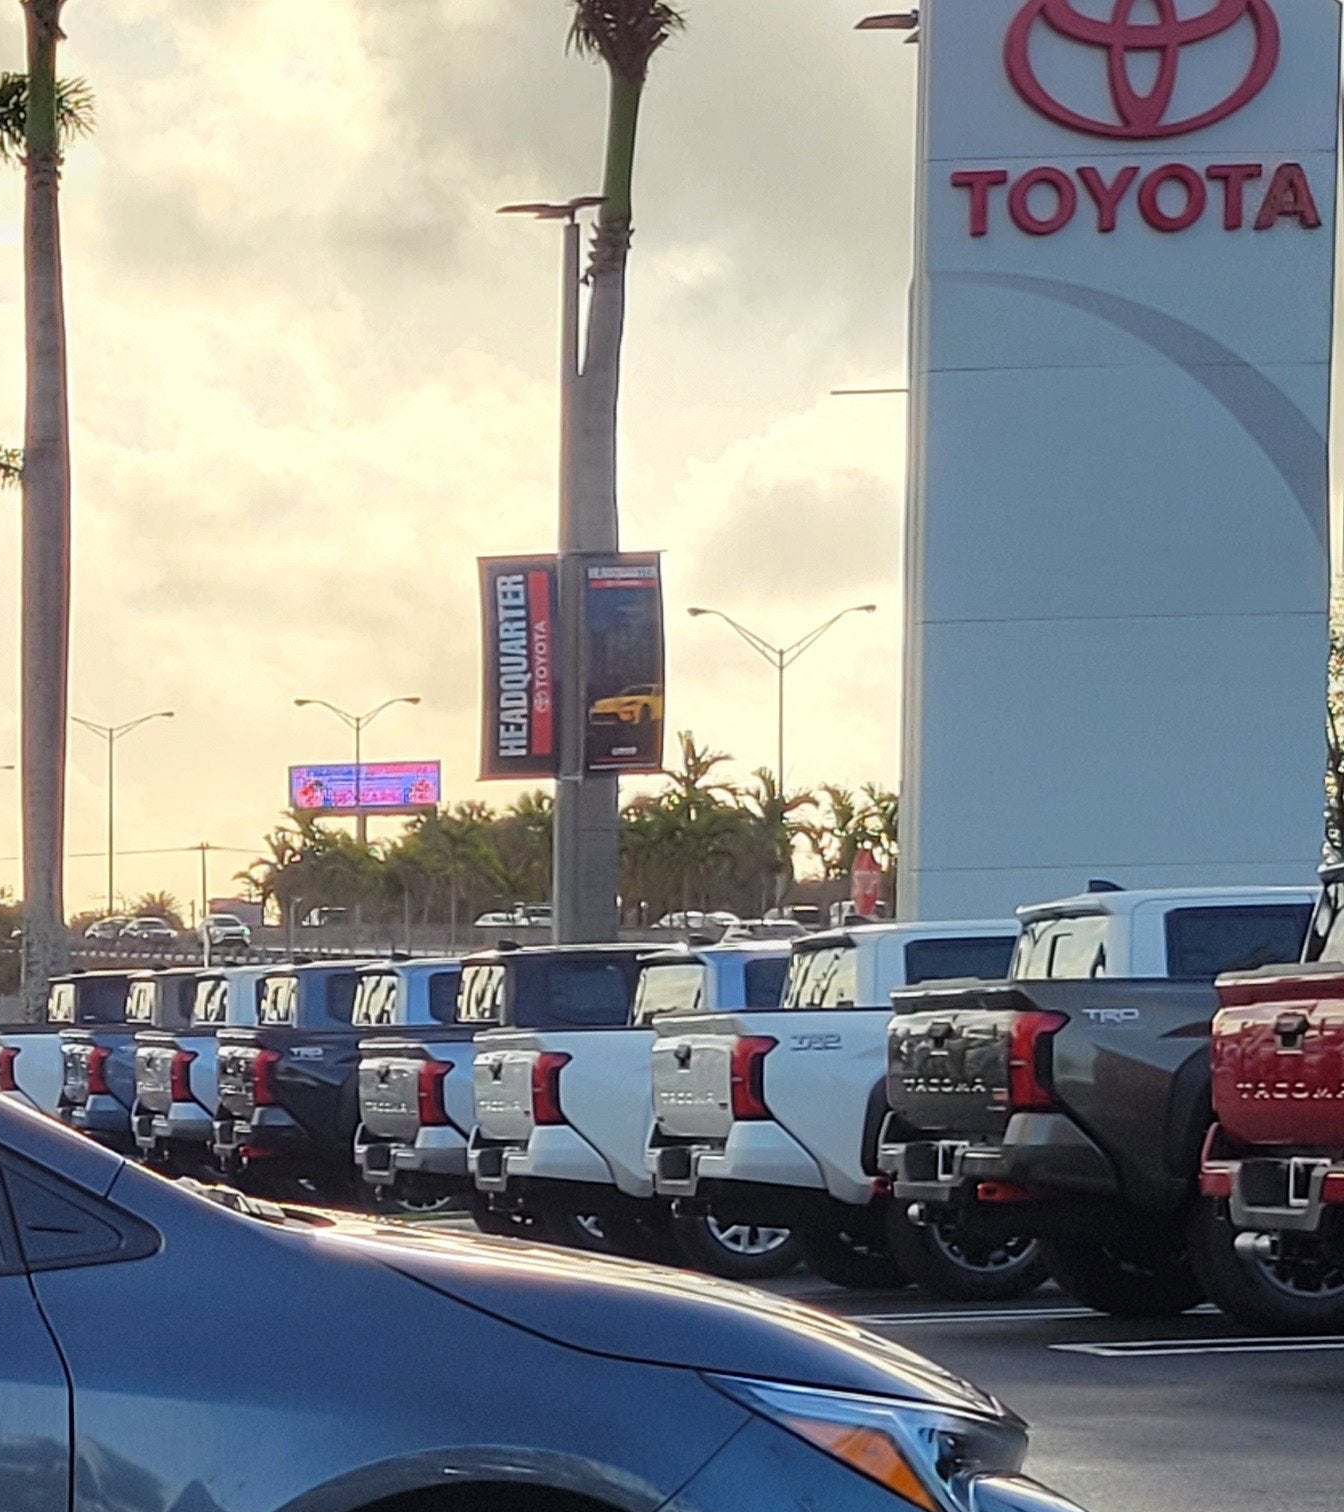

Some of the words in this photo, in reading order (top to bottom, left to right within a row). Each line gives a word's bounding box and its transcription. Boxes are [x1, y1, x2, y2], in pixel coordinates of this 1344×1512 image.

[951, 163, 1322, 237] TOYOTA
[496, 574, 531, 757] HEADQUARTER
[534, 621, 548, 688] TOYOTA
[1081, 1008, 1140, 1023] TRD
[902, 1078, 986, 1093] TACOMA
